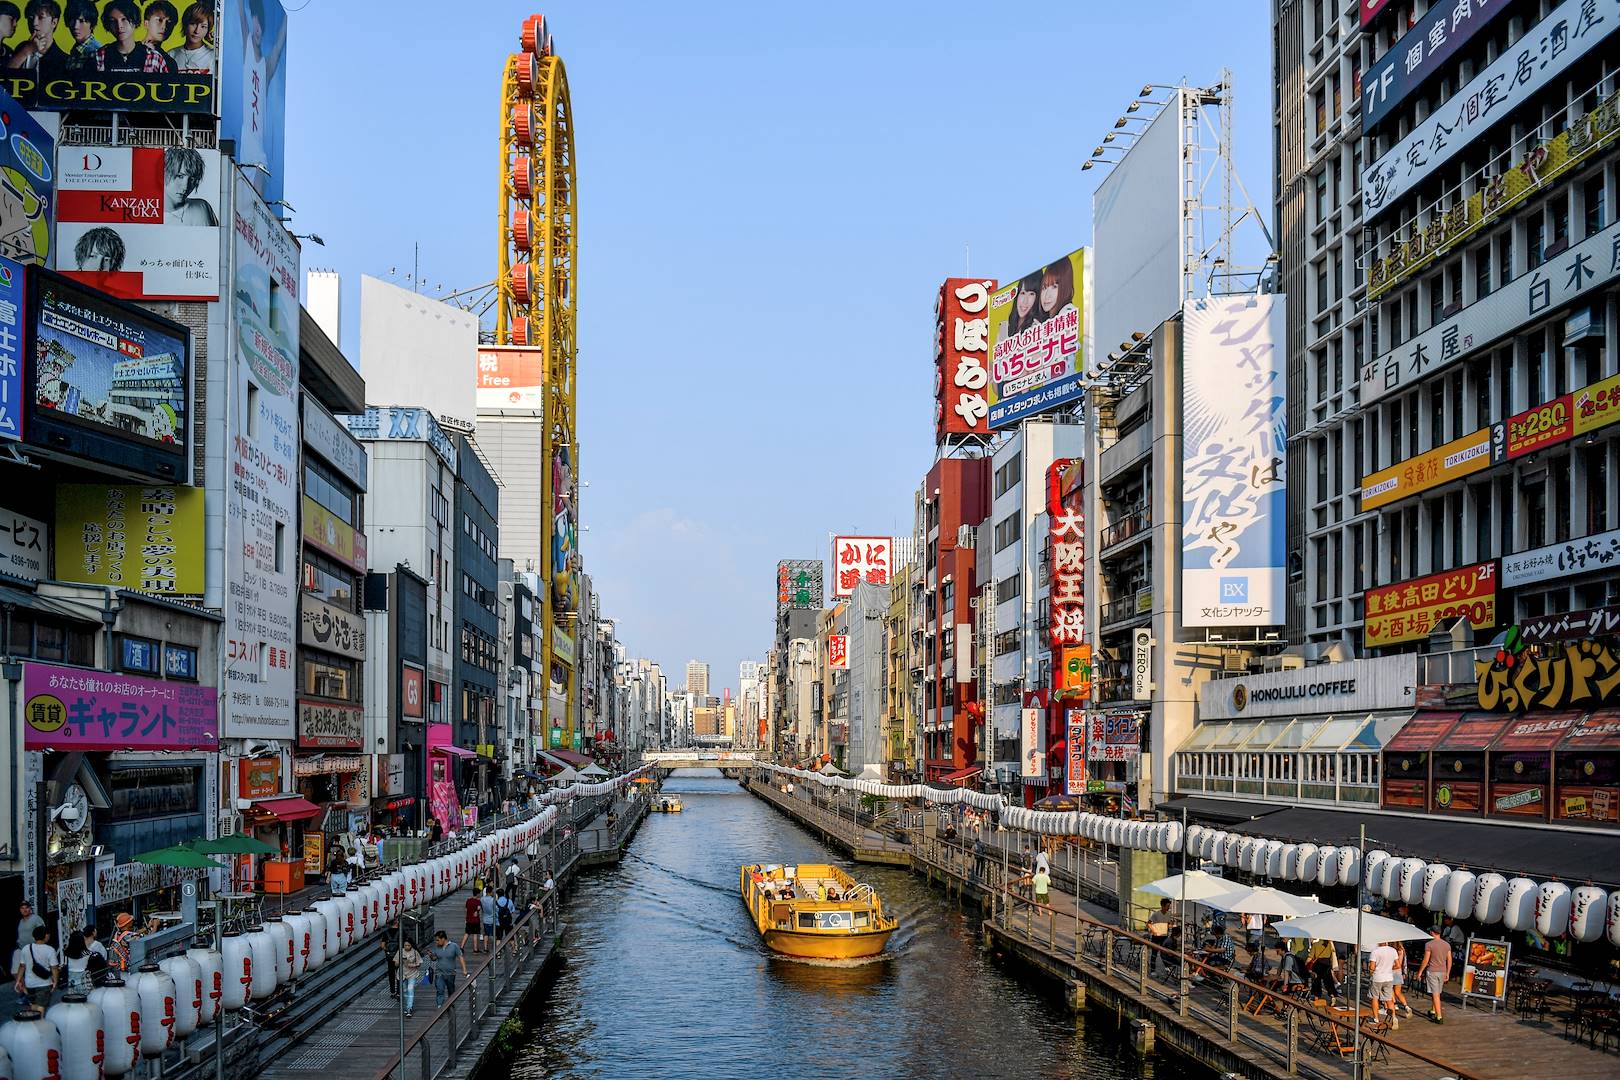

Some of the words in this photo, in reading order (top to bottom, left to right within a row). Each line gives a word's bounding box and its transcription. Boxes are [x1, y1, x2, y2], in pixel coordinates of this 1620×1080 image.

[1366, 63, 1394, 114] 7F
[1404, 0, 1488, 74] 個室肉
[45, 80, 210, 103] GROUP
[1406, 0, 1604, 176] 完全個室居酒屋
[100, 194, 160, 212] KANZAKI
[122, 207, 159, 220] RUKA
[993, 310, 1078, 360] 高収入お仕事情報
[994, 327, 1077, 383] いちごナビ
[1363, 363, 1378, 383] 4F
[1384, 324, 1460, 390] 白木屋
[483, 375, 510, 386] Free
[1362, 480, 1394, 499] TORIKIZOKU
[1446, 444, 1486, 468] TORIKIZOKU
[83, 522, 102, 574] 応援します
[106, 488, 125, 582] あなたのお店づくり
[11, 554, 40, 571] 4396-7000
[840, 543, 886, 565] かに
[1505, 561, 1520, 574] 大阪
[1522, 553, 1553, 569] お好み焼
[1052, 508, 1084, 641] 大阪王将
[1224, 583, 1245, 597] BX
[1366, 572, 1477, 616] 豊後高田どり
[1478, 563, 1494, 579] 2F
[1383, 611, 1430, 637] 酒場
[1522, 609, 1620, 639] ハンバーグレ
[269, 646, 291, 670] 最高!
[1137, 648, 1146, 674] ZERO
[50, 674, 174, 700] あなたも憧れのお店のオーナーに!
[1251, 685, 1306, 702] HONOLULU
[1309, 679, 1356, 696] COFFEE
[32, 702, 61, 724] 賃貸
[68, 697, 176, 738] ギャラント
[1092, 716, 1104, 742] 薬
[1104, 746, 1124, 758] 免税
